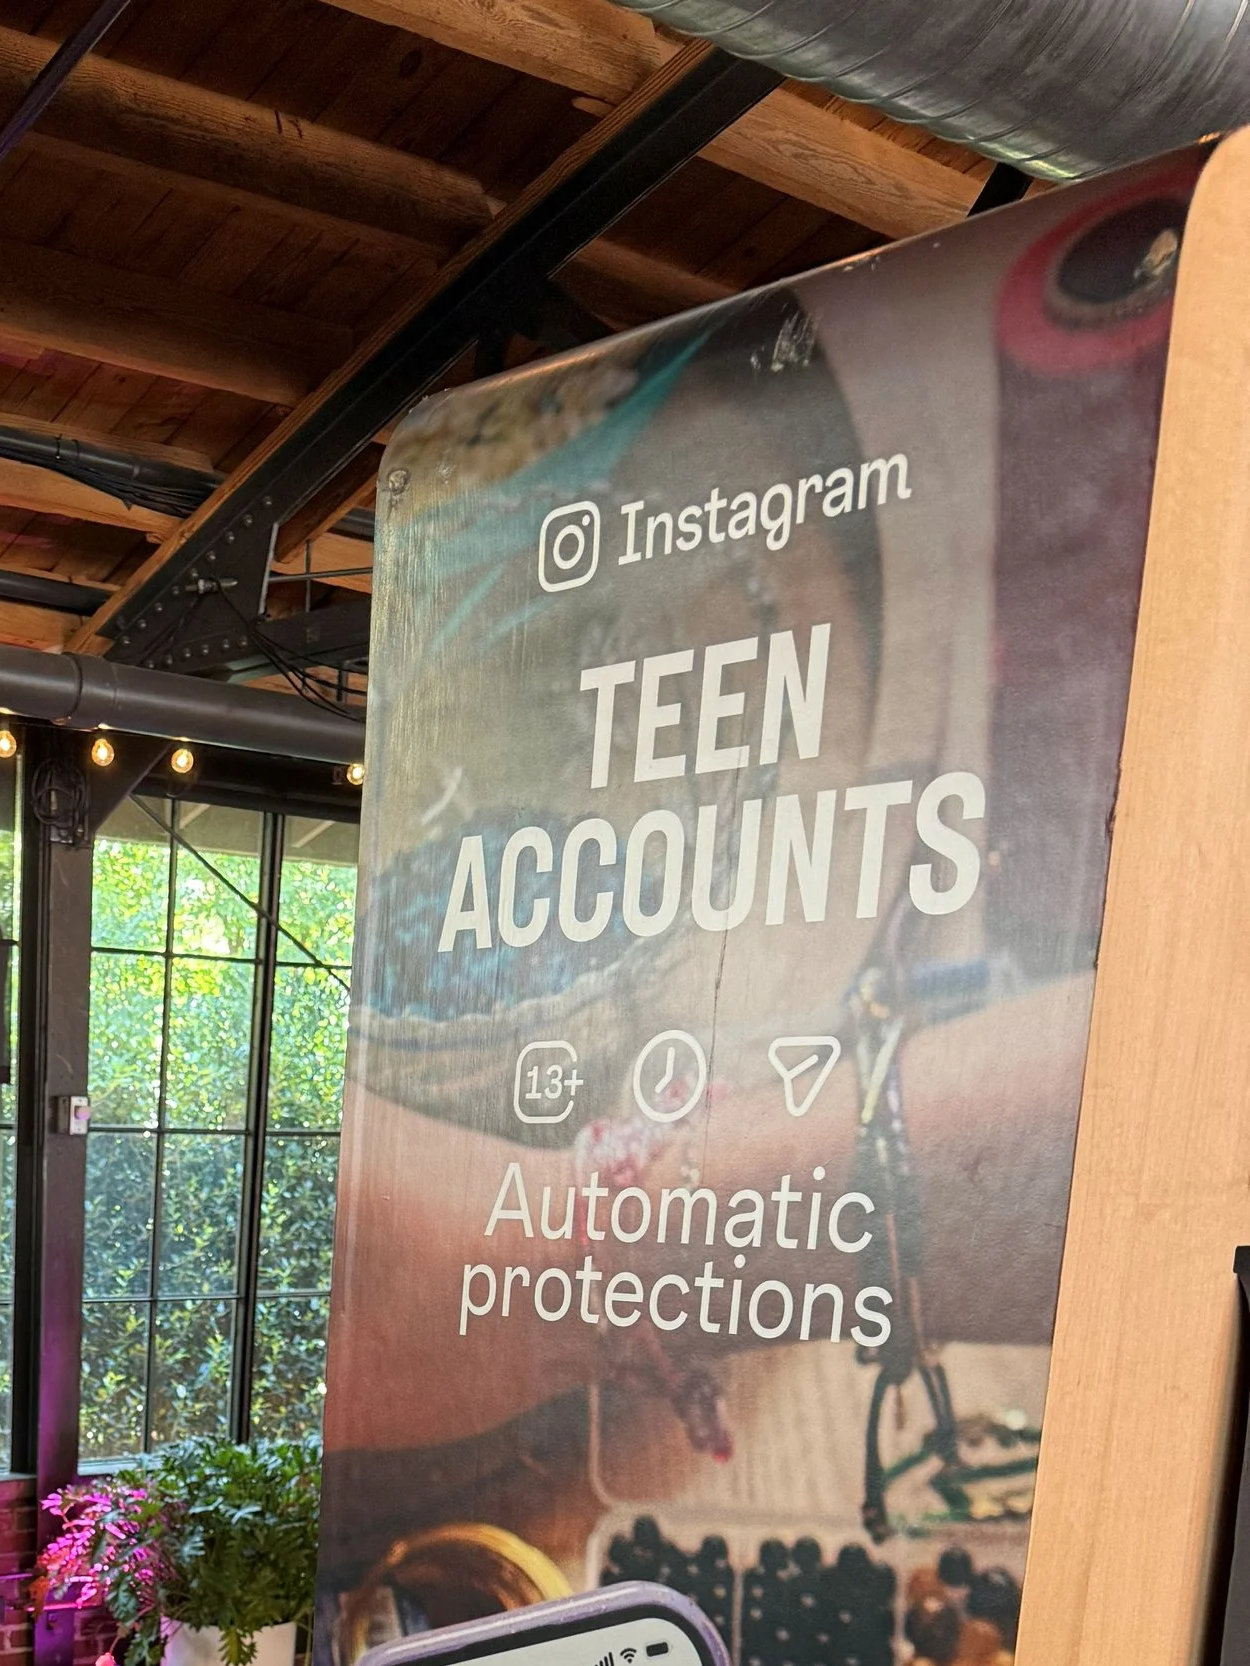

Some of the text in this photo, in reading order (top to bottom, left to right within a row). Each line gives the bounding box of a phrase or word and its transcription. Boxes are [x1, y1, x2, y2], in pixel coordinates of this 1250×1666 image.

[617, 453, 912, 565] Instagram
[579, 622, 831, 789] TEEN
[438, 771, 986, 953] ACCOUNTS
[525, 1061, 584, 1102] 13+
[484, 1161, 876, 1254] Automatic
[459, 1253, 894, 1348] protections
